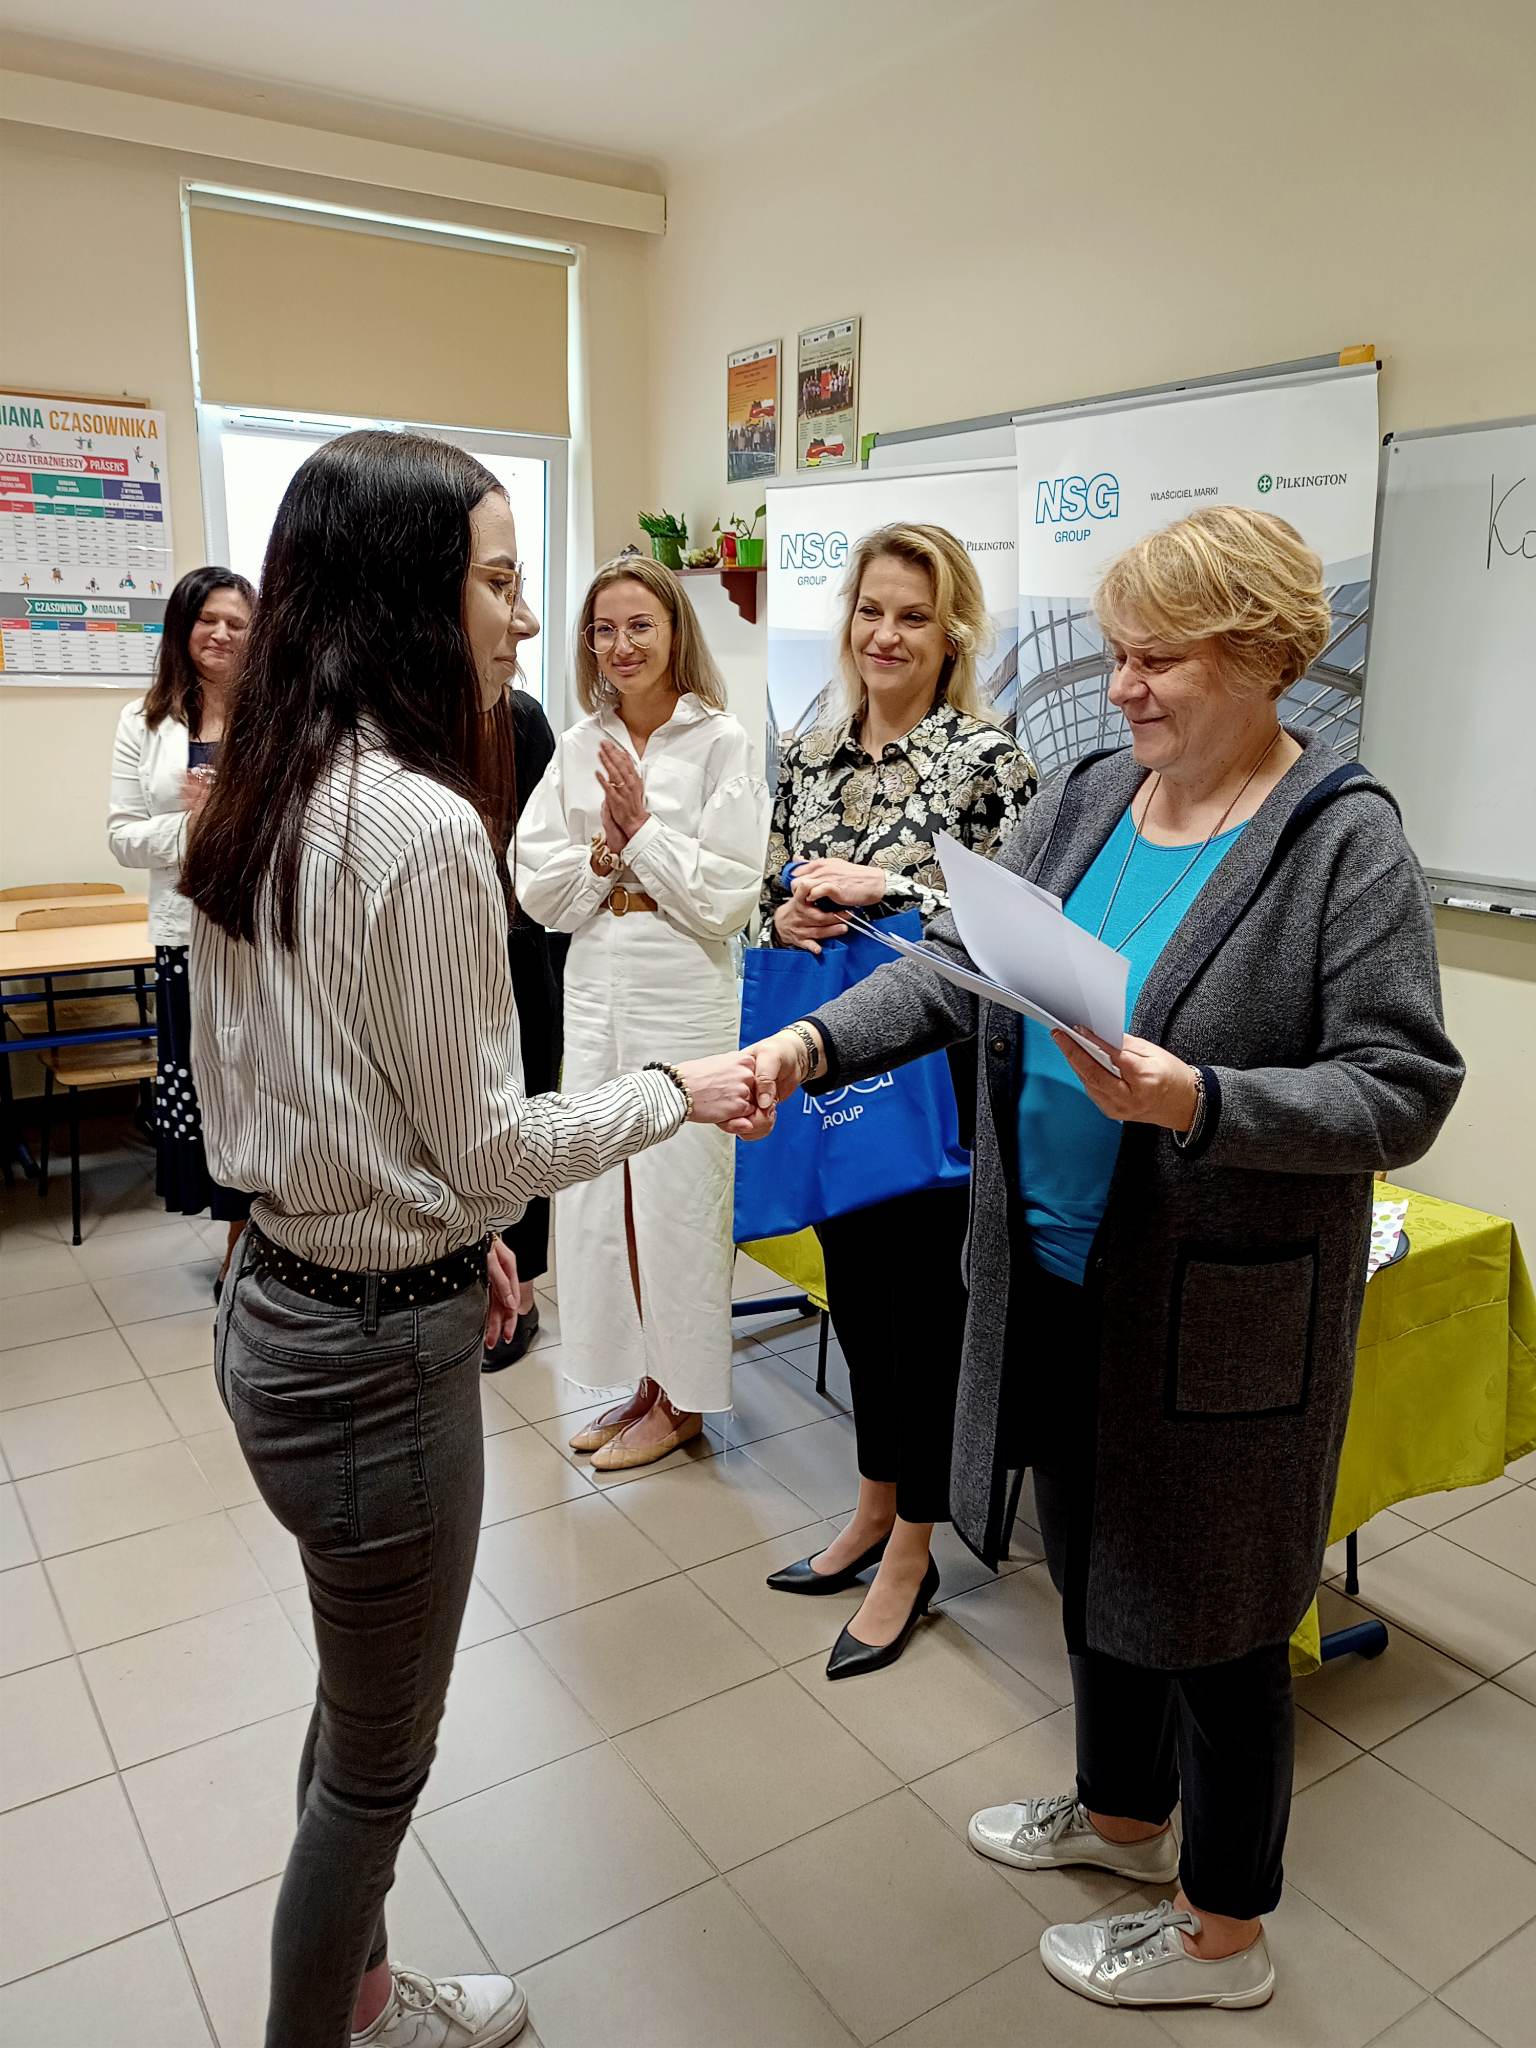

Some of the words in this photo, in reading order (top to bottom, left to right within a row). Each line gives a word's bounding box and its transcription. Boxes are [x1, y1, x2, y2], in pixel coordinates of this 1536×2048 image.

[0, 405, 44, 429] IANA
[49, 410, 158, 439] CZASOWNIKA
[6, 453, 27, 464] CZAS
[1275, 473, 1347, 489] PILKINGTON
[1036, 473, 1119, 523] NSG
[1150, 489, 1192, 501] WŁAŚCICIEL
[1194, 486, 1218, 497] MARKI
[1055, 529, 1091, 542] GROUP
[780, 531, 848, 569] NSG
[966, 541, 1015, 551] PILKINGTON
[797, 576, 827, 586] GROUP
[34, 601, 83, 614] CZASOWNIKI
[91, 604, 127, 615] MODALNE
[822, 1105, 864, 1131] ROUP
